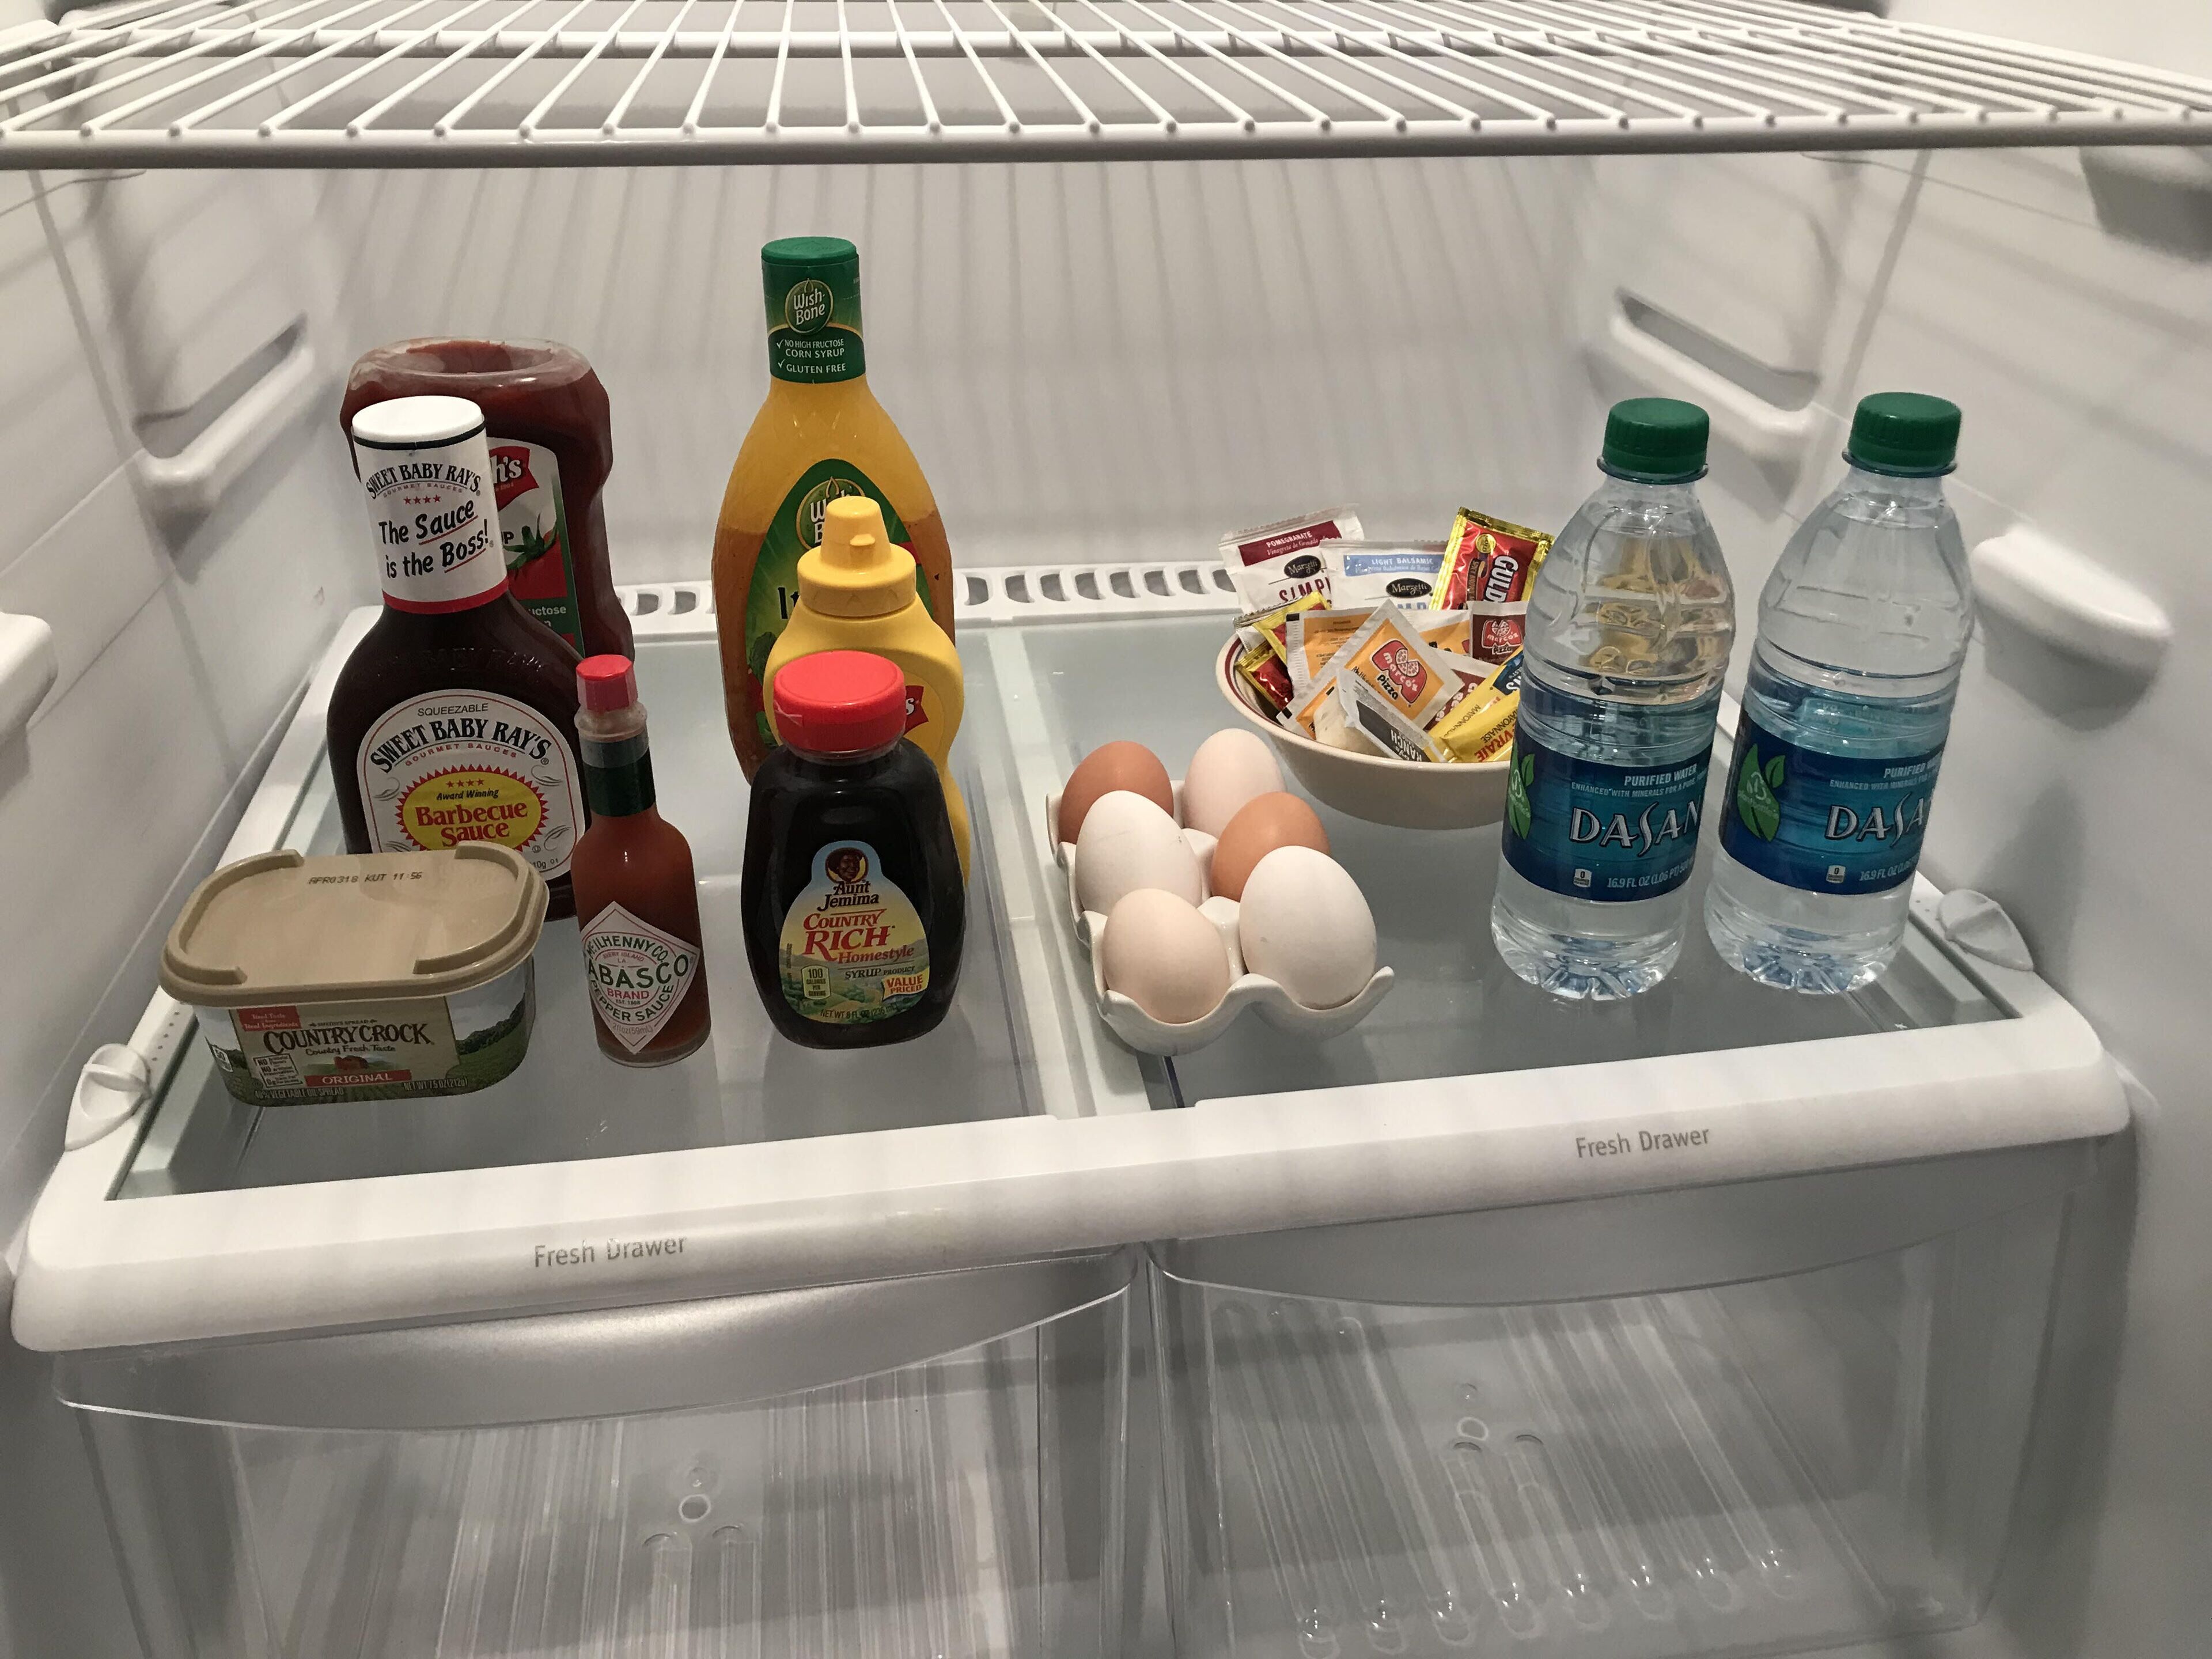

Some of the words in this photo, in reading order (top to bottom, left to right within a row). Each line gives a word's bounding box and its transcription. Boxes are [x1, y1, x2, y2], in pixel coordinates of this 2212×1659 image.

[794, 289, 825, 310] Wish-
[796, 304, 825, 325] Bone
[785, 339, 794, 347] NO
[795, 340, 811, 349] HIGH
[813, 338, 844, 349] FRUCTOSE
[785, 349, 812, 358] CORN
[815, 347, 845, 358] SYRUP
[786, 363, 823, 373] GLUTEN
[826, 363, 846, 373] FREE
[365, 467, 397, 499] SWEET
[400, 463, 444, 481] BABY
[446, 464, 481, 493] RAY'S
[383, 483, 421, 498] GOURMET
[427, 482, 463, 493] SAUCES
[378, 520, 408, 545] The
[415, 499, 474, 539] Sauce
[1266, 531, 1313, 548] POMEGRANATE
[386, 555, 397, 579] is
[403, 551, 433, 576] the
[439, 518, 488, 567] Boss!
[1288, 560, 1319, 575] Marzetti
[1485, 556, 1518, 602] GULD
[1391, 582, 1427, 594] Marzetti
[528, 606, 566, 616] uctose
[1377, 674, 1399, 700] Pizza
[416, 702, 489, 717] SQUEEZABLE
[370, 725, 430, 773] SWEET
[429, 718, 489, 741] BABY
[492, 722, 552, 760] RAY'S
[1391, 729, 1422, 762] RANCH
[1475, 729, 1513, 762] VRAIE
[405, 743, 460, 767] GOURMET
[467, 743, 517, 759] SAUCES
[1624, 772, 1671, 786] PURIFIED
[1673, 763, 1697, 781] WATER
[1883, 763, 1926, 779] PURIFIED
[1571, 782, 1608, 796] ENHANCED
[1611, 789, 1630, 798] WITH
[1632, 787, 1664, 798] MINERALS
[1829, 779, 1869, 790] ENHANCED
[436, 789, 464, 801] Award
[465, 788, 499, 800] Winning
[414, 801, 528, 827] Barbecue
[1825, 791, 1925, 848] DASA
[441, 823, 510, 849] Sauce
[1570, 801, 1698, 857] DASAN
[532, 860, 546, 869] 10g
[364, 873, 387, 882] KUT
[1877, 869, 1887, 878] FL
[834, 880, 870, 896] Aunt
[1607, 877, 1625, 888] 16.9
[1626, 877, 1637, 888] FL
[1638, 876, 1651, 888] OZ
[817, 893, 880, 911] Jemima
[802, 926, 890, 961] RICH
[838, 945, 915, 964] Homestyle
[588, 954, 689, 988] ABASCO
[808, 968, 823, 978] 100
[845, 968, 881, 979] SYRUP
[883, 965, 915, 975] PRODUCT
[887, 974, 923, 988] VALUE
[891, 984, 922, 994] PRICED
[591, 979, 631, 1022] PEPPER
[635, 984, 674, 1021] SAUCE
[607, 987, 650, 999] BRAND
[820, 1009, 834, 1018] NET
[834, 1010, 845, 1018] WT
[846, 1010, 850, 1018] 8
[851, 1010, 858, 1018] FL
[263, 1026, 358, 1055] COUNTRY
[359, 1023, 431, 1046] CROCK
[305, 1046, 342, 1056] Country
[344, 1045, 370, 1054] Fresh
[371, 1044, 396, 1053] Taste
[321, 1072, 393, 1085] ORIGINAL
[1575, 1132, 1631, 1158] Fresh
[1638, 1128, 1709, 1152] Drawer
[535, 1239, 594, 1267] Fresh
[607, 1237, 687, 1260] Drawer
